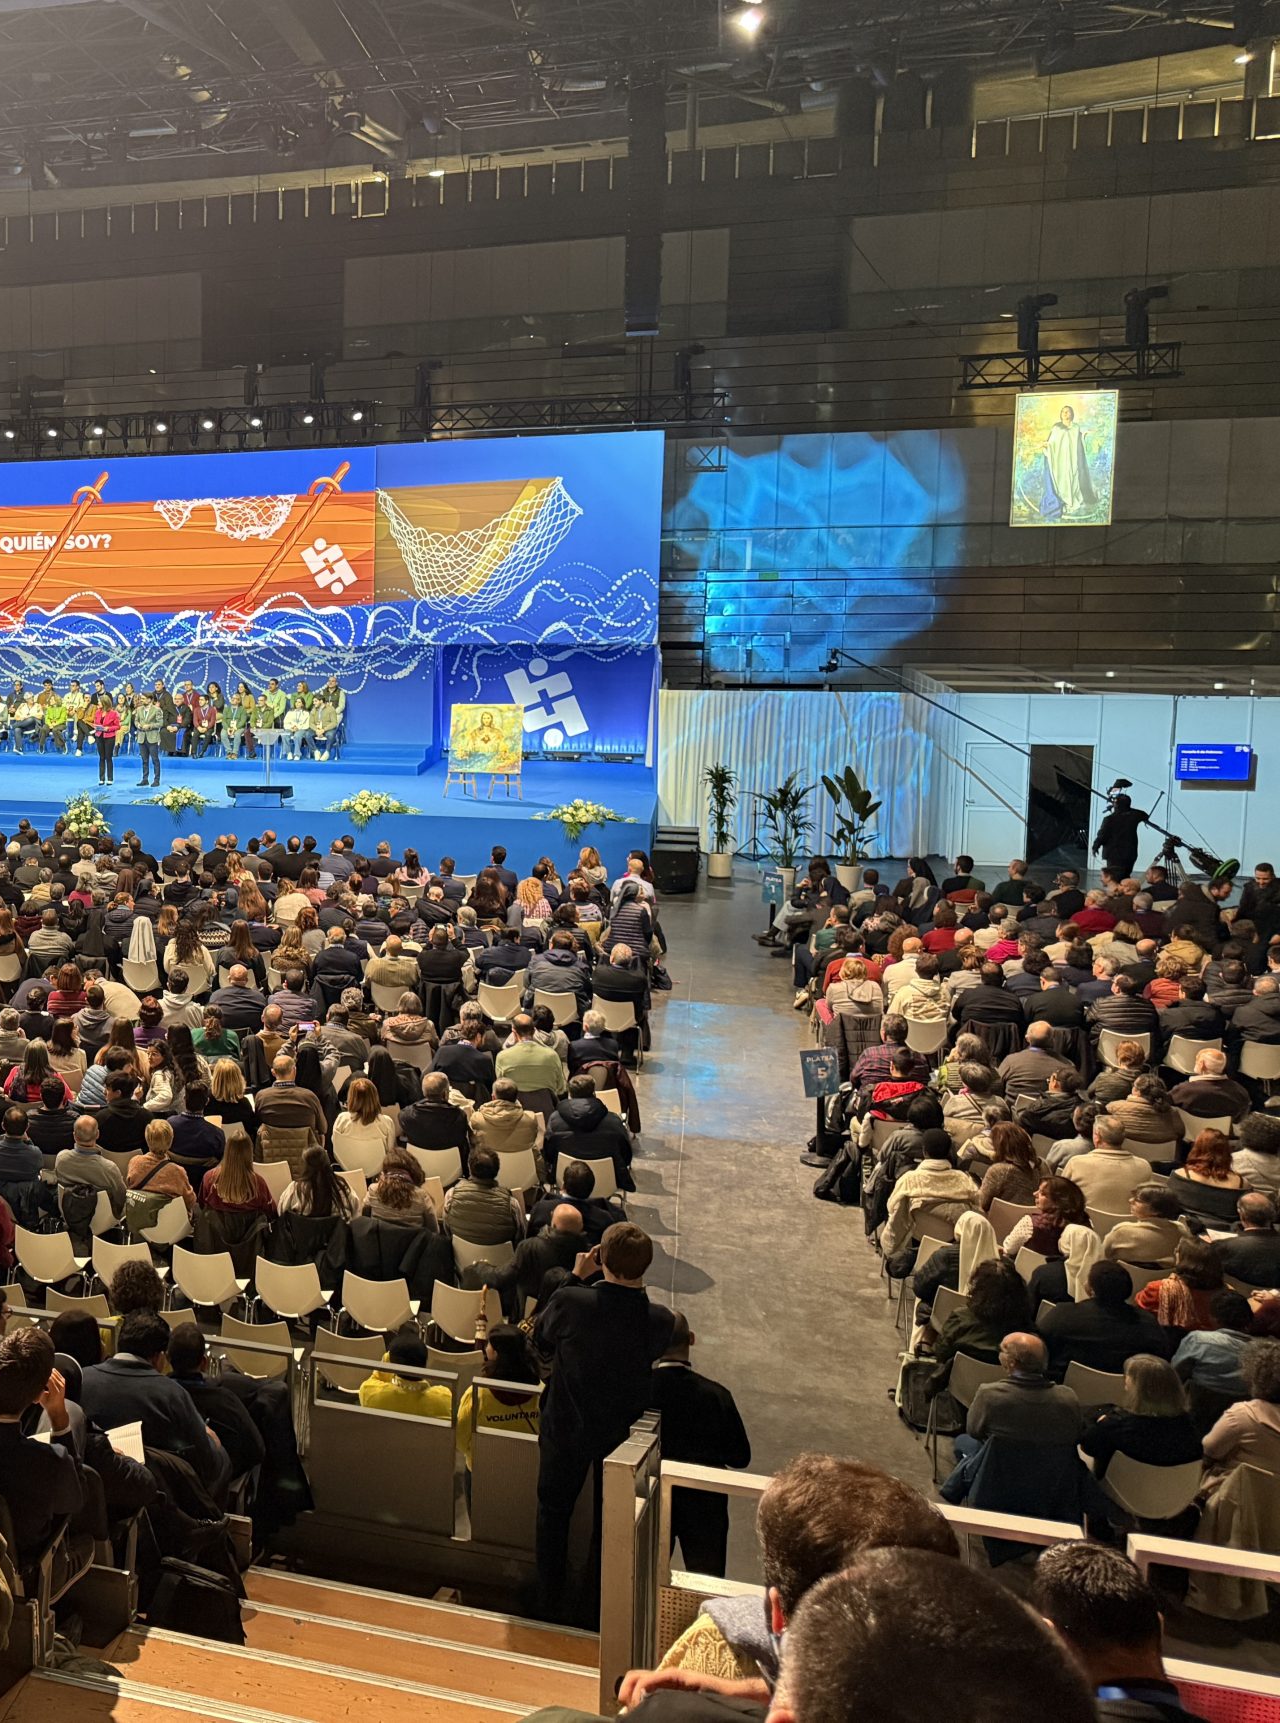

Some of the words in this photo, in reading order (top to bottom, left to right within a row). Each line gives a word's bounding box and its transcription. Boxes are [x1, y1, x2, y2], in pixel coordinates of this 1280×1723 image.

[0, 532, 57, 553] QUIÉN
[63, 533, 112, 550] SOY?
[770, 884, 776, 893] 1
[806, 1054, 835, 1063] PLATEA
[817, 1067, 828, 1079] 5
[486, 1411, 539, 1422] VOLUNTARI
